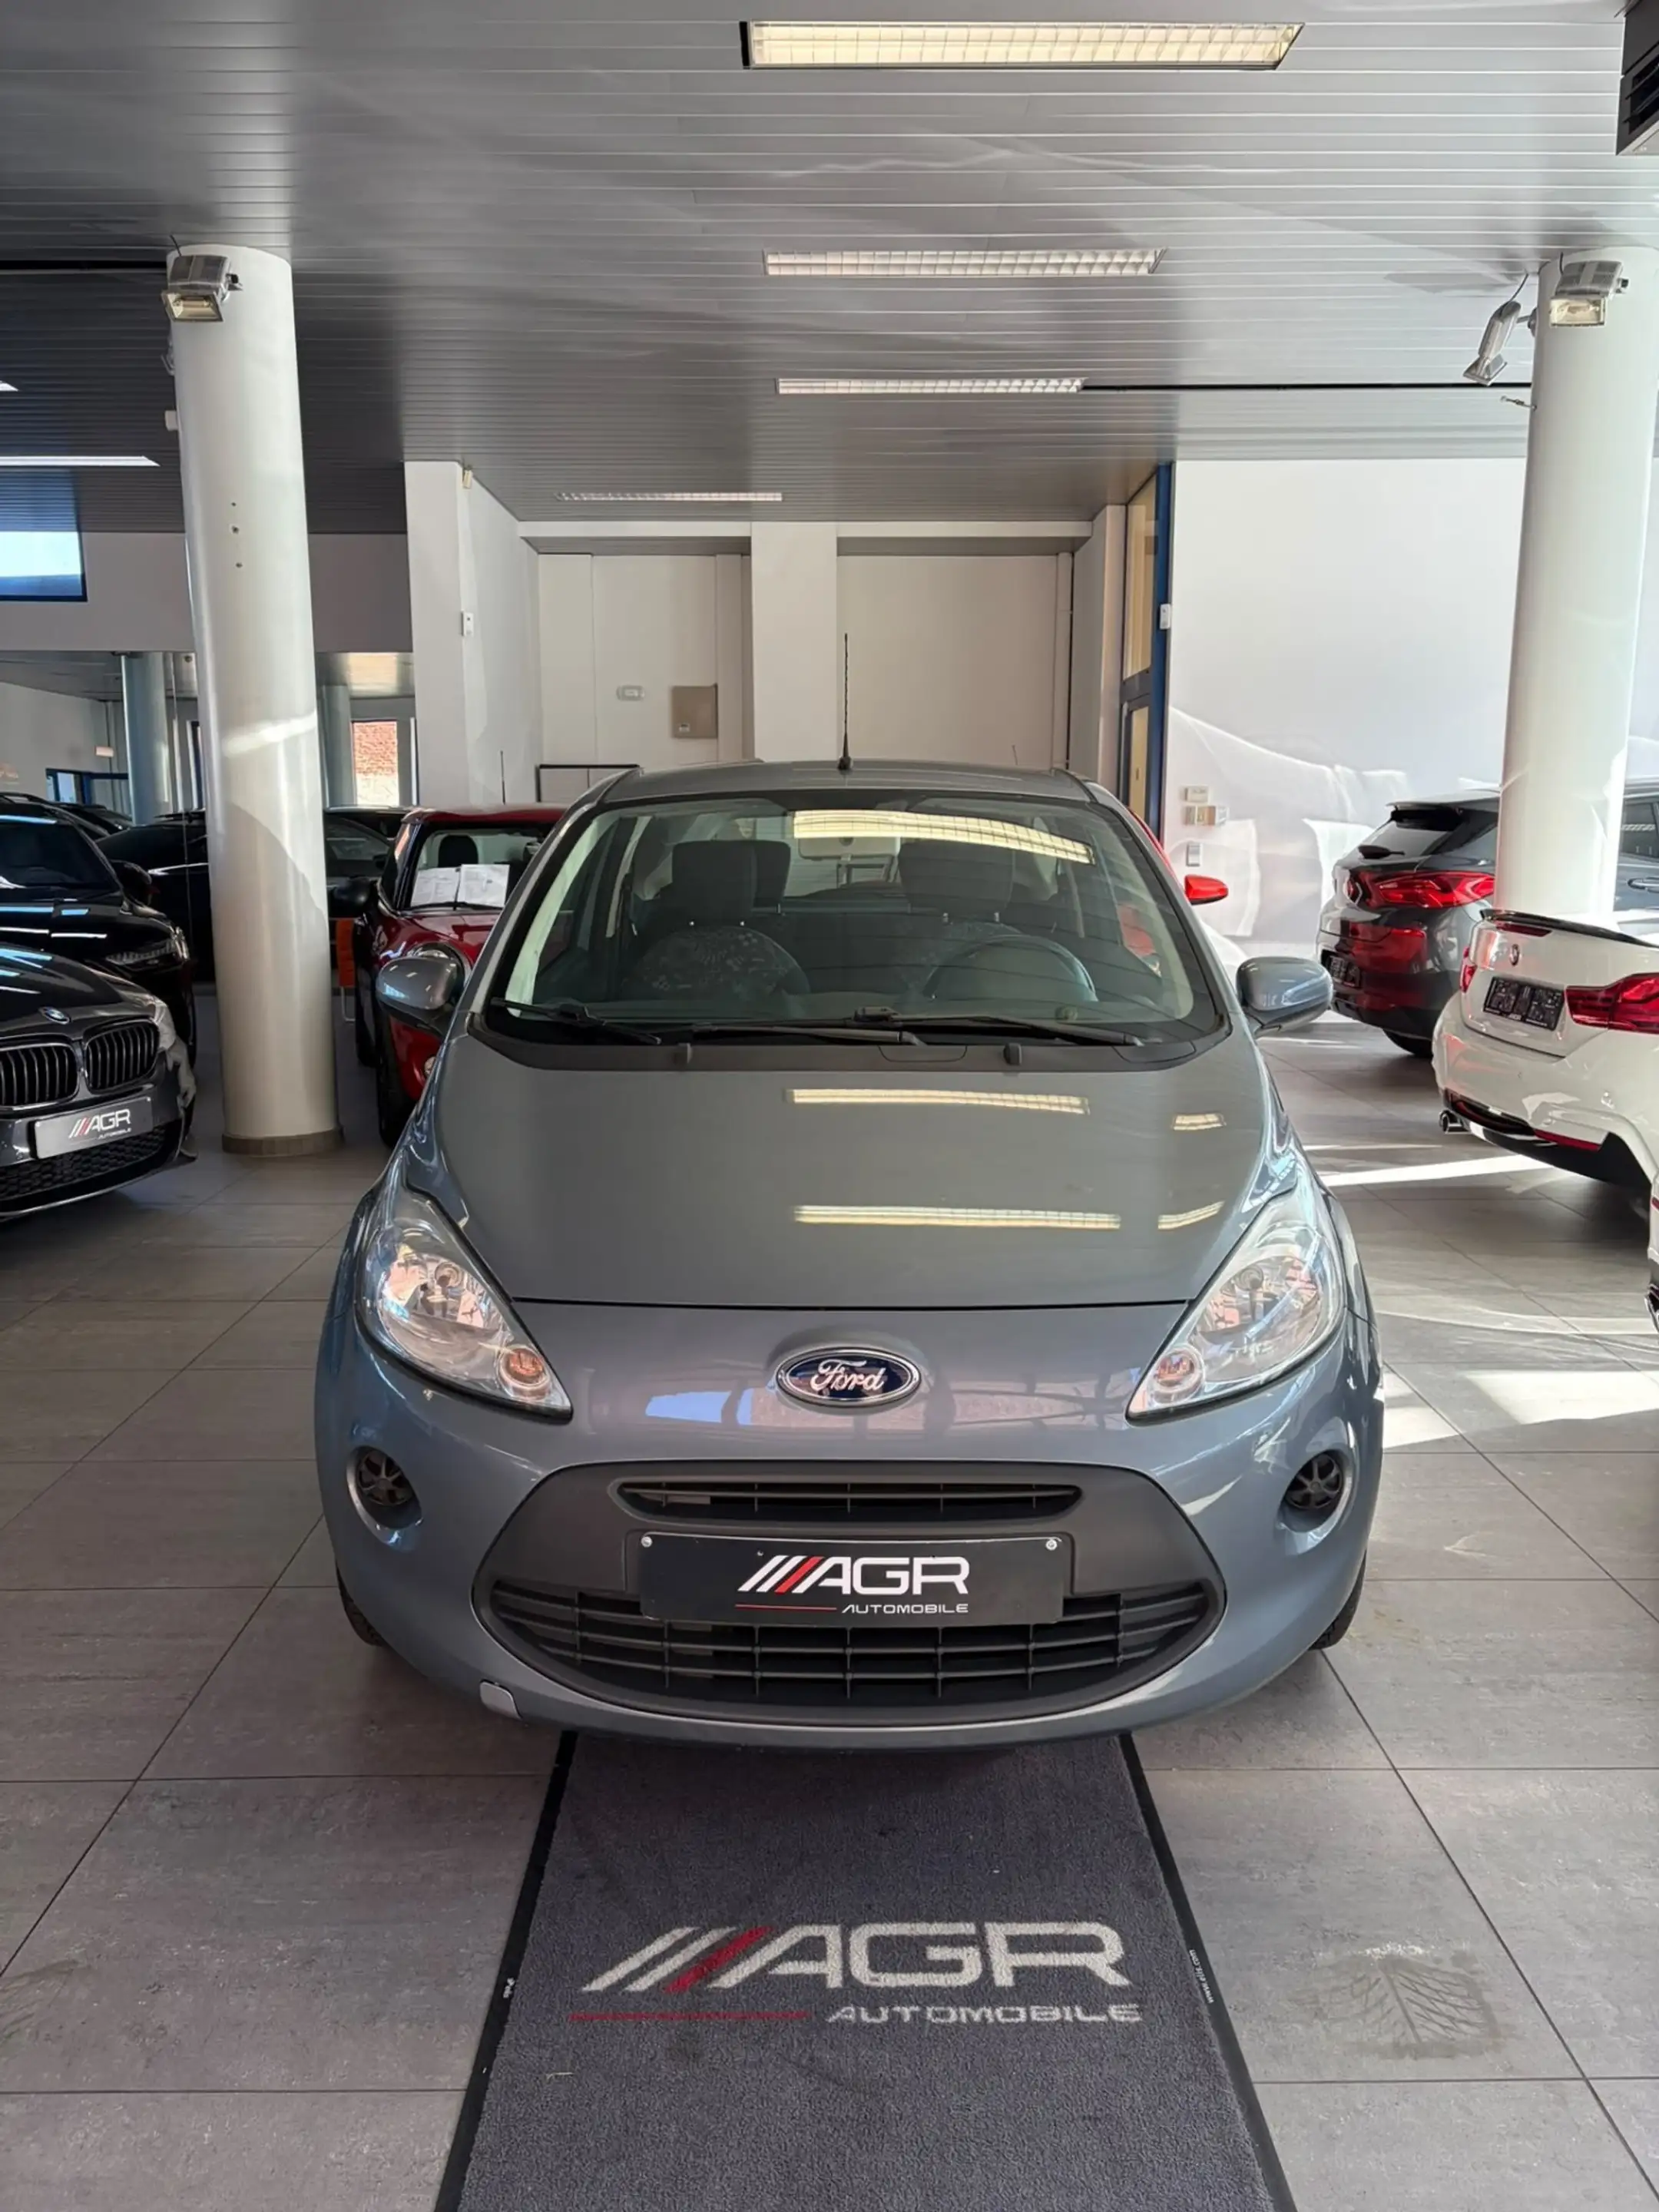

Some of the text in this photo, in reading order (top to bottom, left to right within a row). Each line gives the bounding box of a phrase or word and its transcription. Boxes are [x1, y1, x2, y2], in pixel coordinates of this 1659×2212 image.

[86, 1108, 131, 1135] AGR
[810, 1358, 886, 1392] Ford
[790, 1555, 970, 1595] AGR
[841, 1603, 969, 1614] AUTOMOBILE
[706, 1922, 1134, 1989] AGR
[825, 2003, 1144, 2024] AUTOMOBILE
